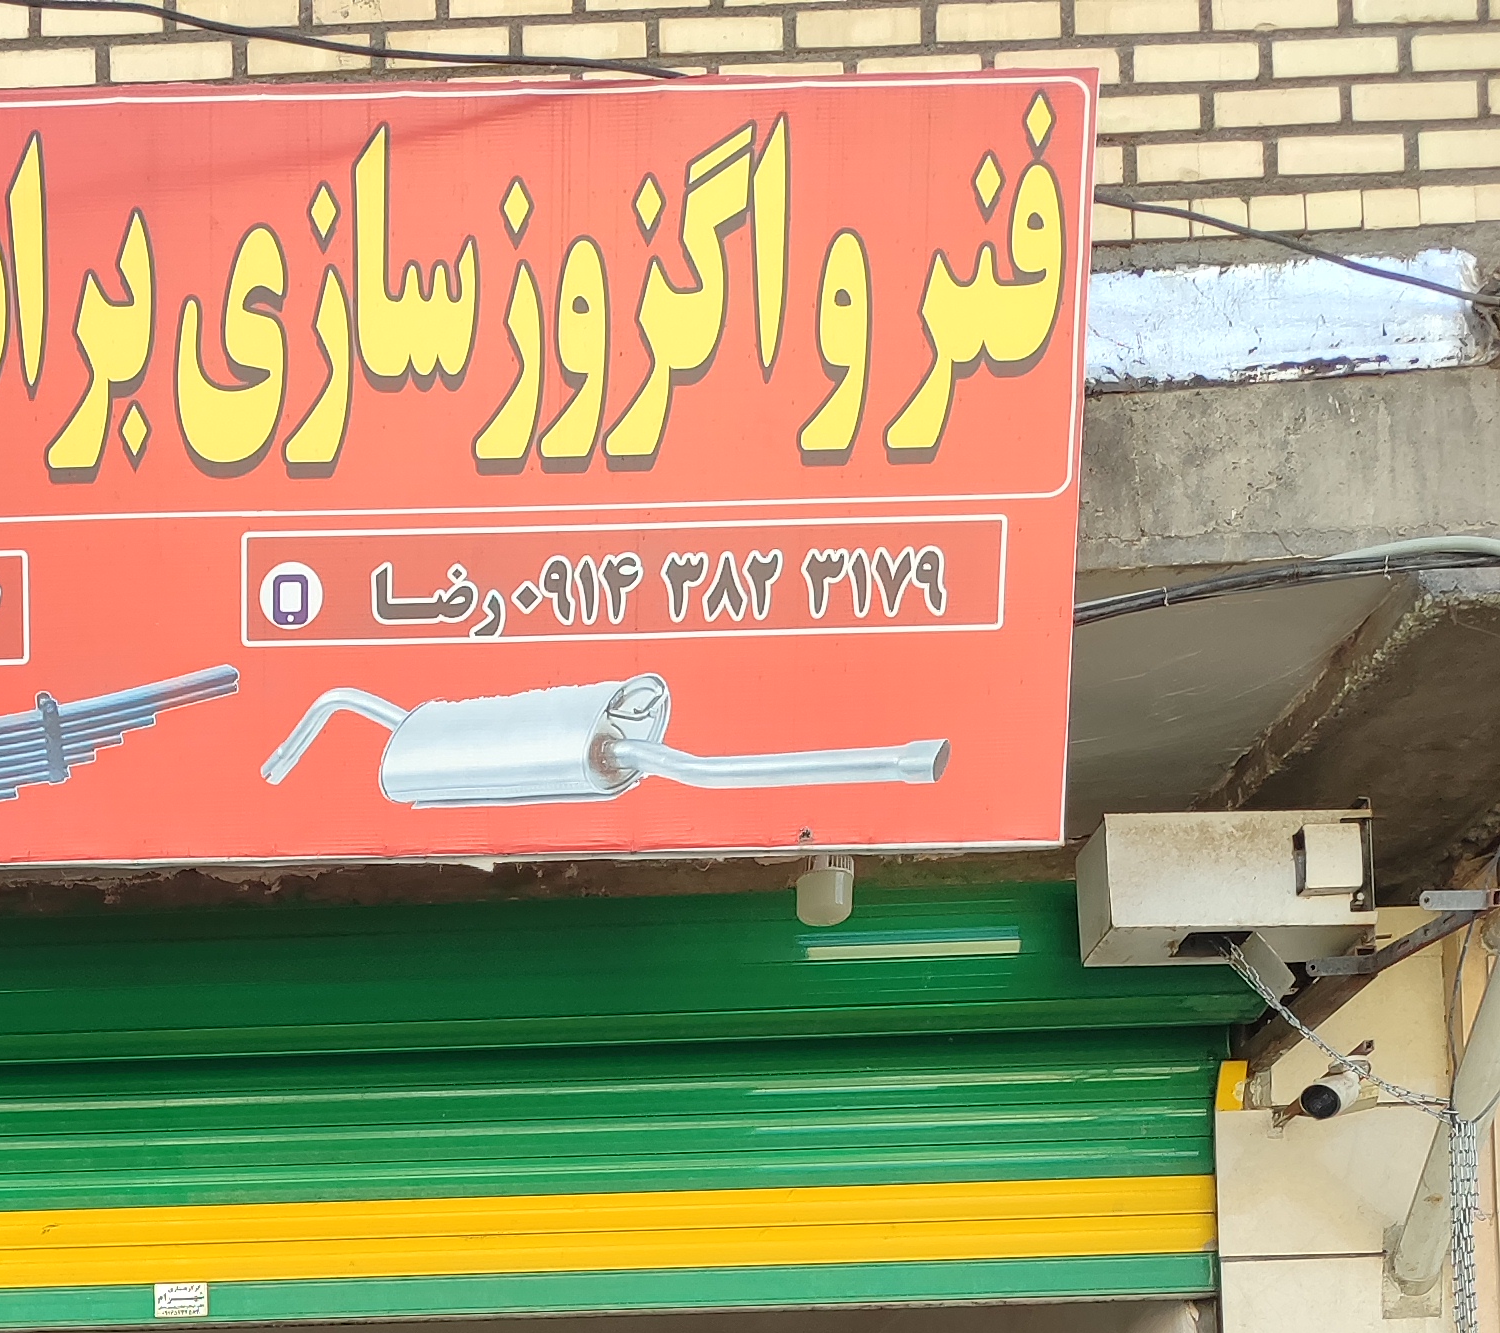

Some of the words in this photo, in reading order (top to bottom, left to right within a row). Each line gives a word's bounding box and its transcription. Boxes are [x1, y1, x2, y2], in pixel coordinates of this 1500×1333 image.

[799, 229, 872, 465] و
[885, 90, 1066, 463] فنر
[371, 562, 506, 640] رضا
